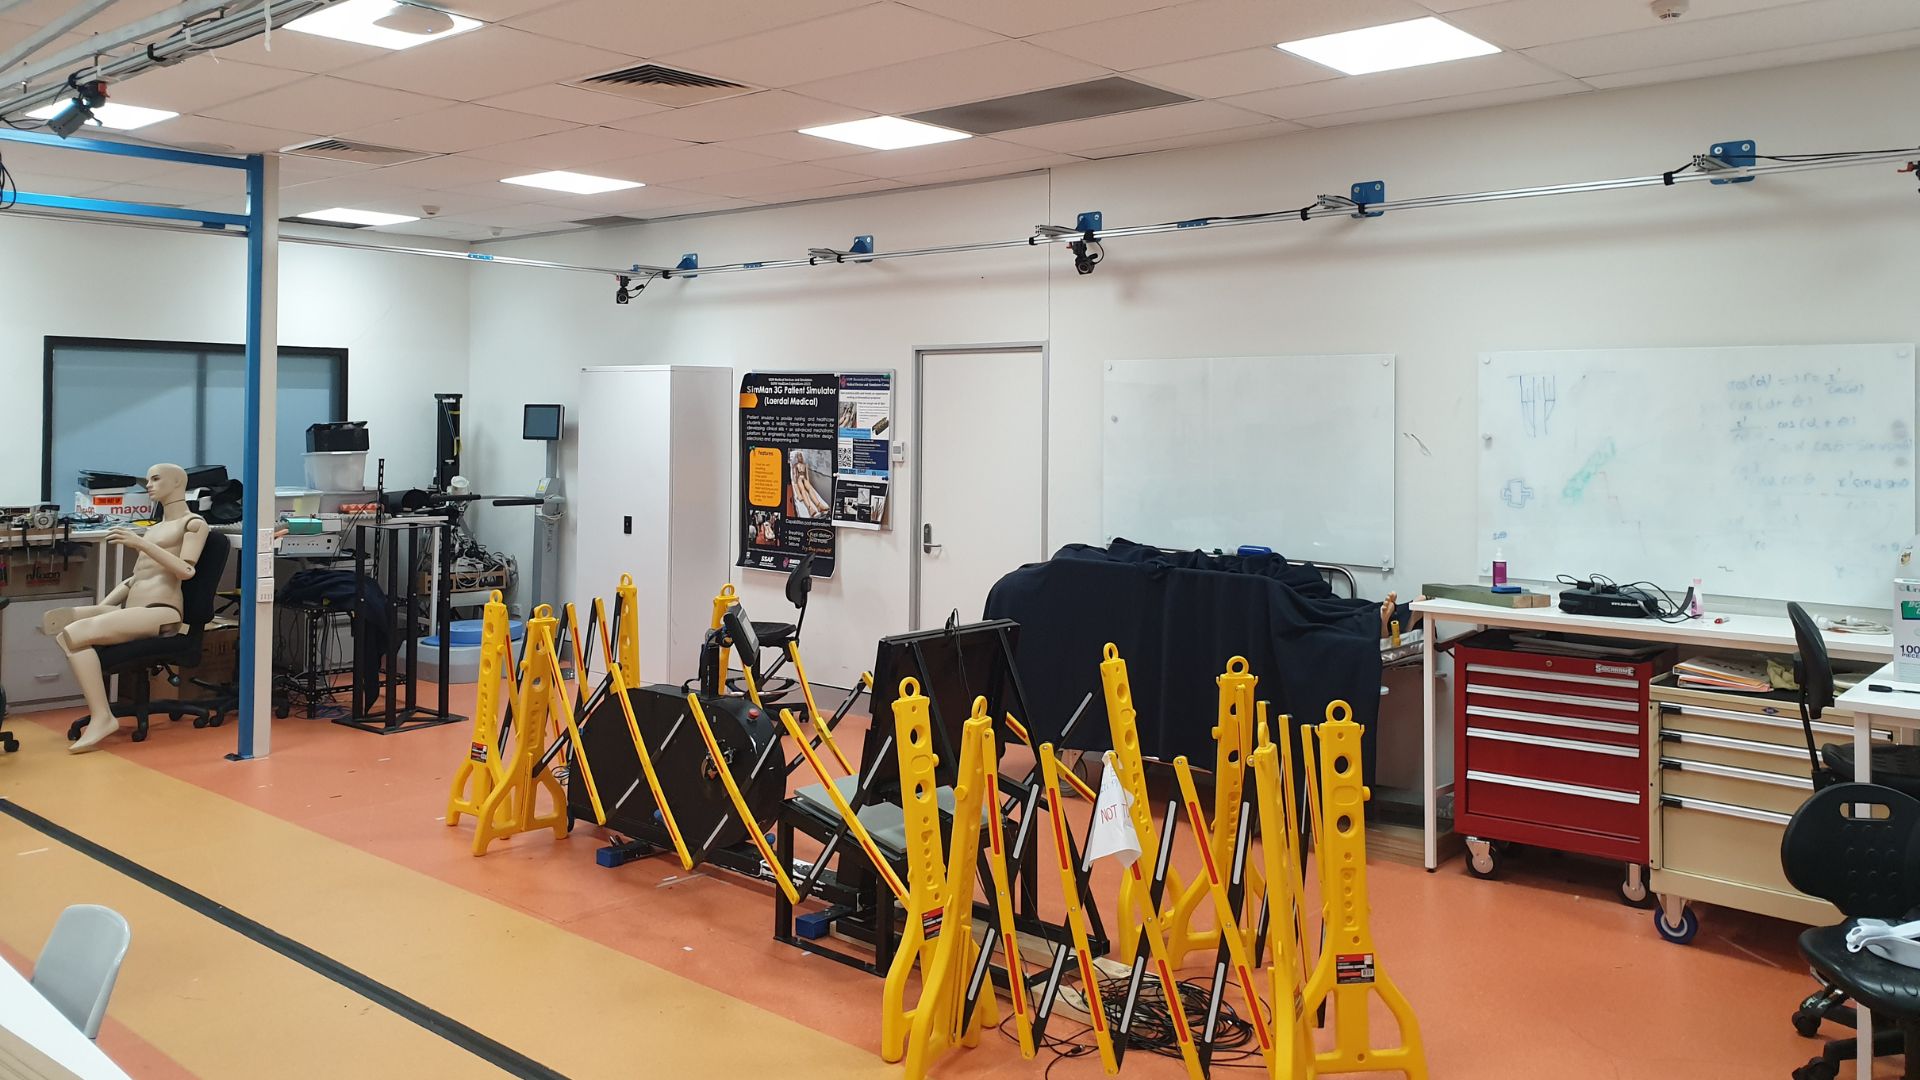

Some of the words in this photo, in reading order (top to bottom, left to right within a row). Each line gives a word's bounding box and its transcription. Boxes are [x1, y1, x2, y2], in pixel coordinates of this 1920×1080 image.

[806, 386, 836, 395] Simulator
[764, 397, 789, 406] (Laerdal
[790, 398, 818, 407] Medical)
[1100, 804, 1117, 824] NOT
